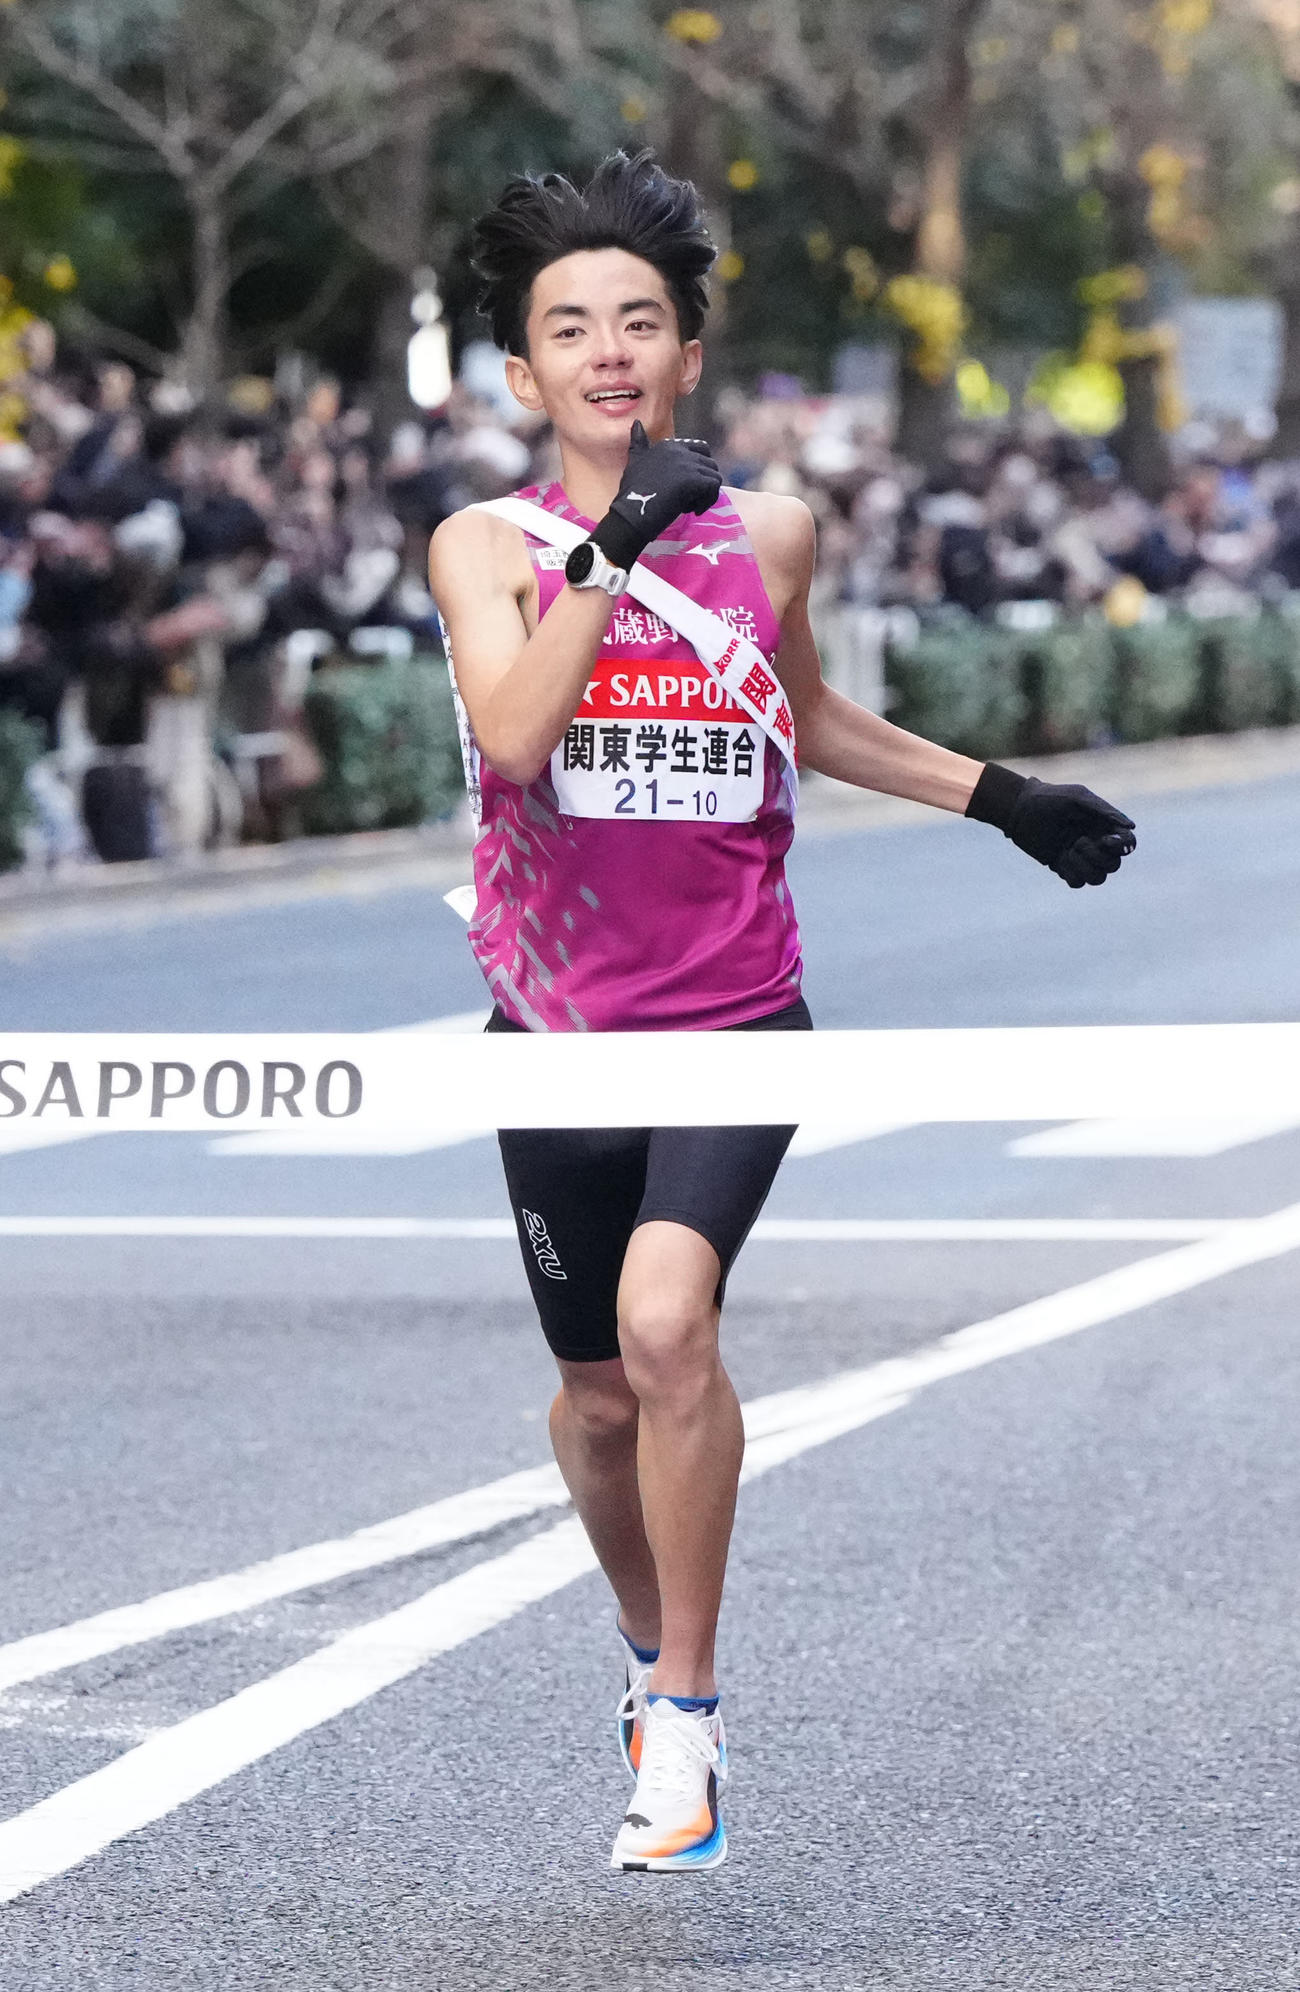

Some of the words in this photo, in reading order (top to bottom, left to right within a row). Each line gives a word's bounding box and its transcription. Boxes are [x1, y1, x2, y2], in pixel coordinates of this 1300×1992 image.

[602, 605, 759, 645] 蔵野院
[738, 662, 799, 771] 関東
[563, 723, 756, 778] 関東学生連合
[0, 1059, 364, 1119] SAPPORO
[522, 1208, 568, 1280] 2XU
